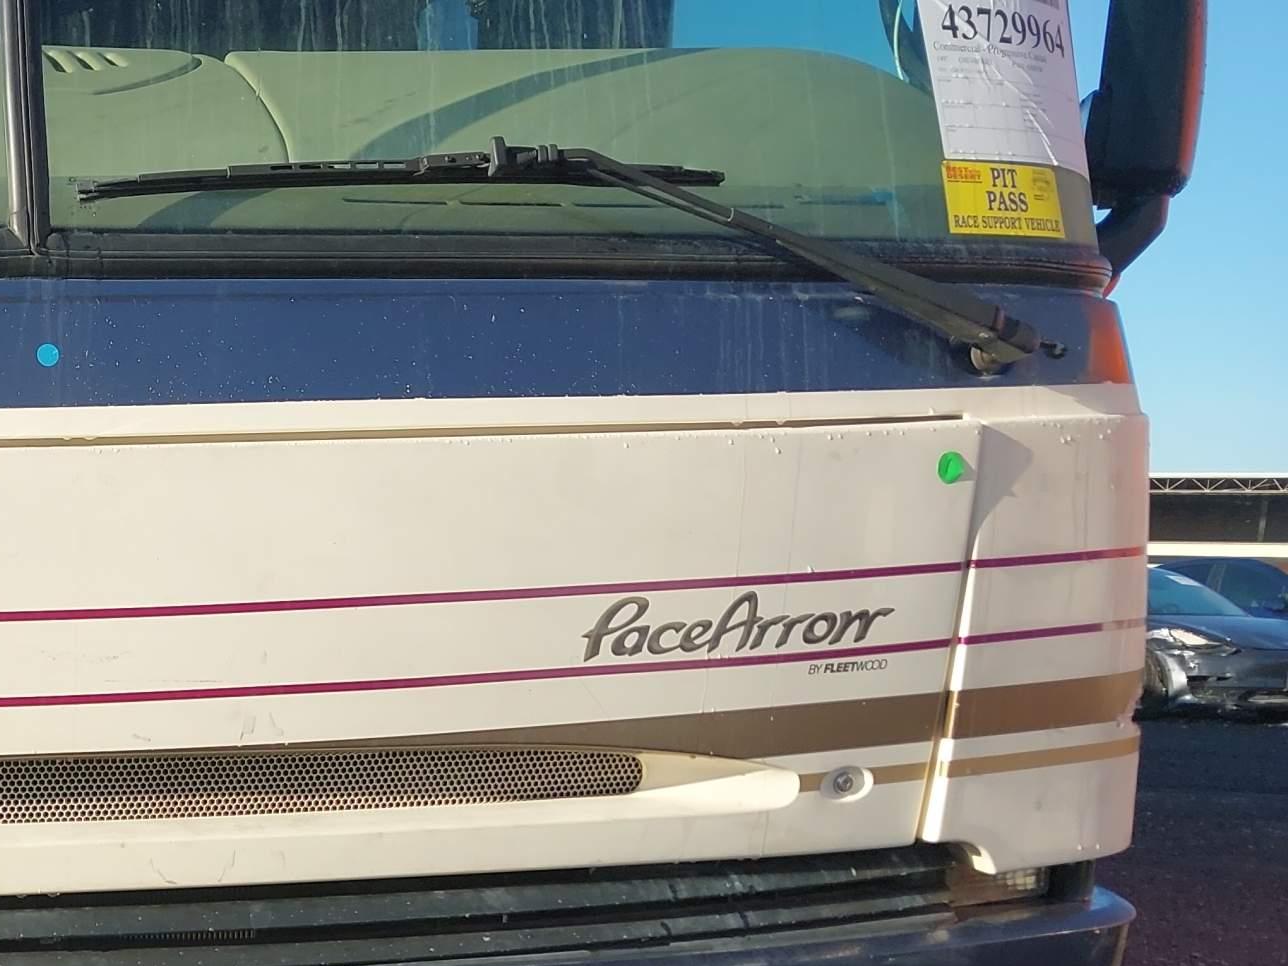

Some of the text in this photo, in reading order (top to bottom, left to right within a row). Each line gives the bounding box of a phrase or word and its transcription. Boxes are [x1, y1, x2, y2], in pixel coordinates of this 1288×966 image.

[941, 4, 1065, 58] 43729964
[990, 167, 1017, 188] PIT
[986, 191, 1029, 213] PASS
[954, 215, 1061, 233] RACE SUPPORT VEHICLE
[808, 659, 887, 675] BY FLEETWOOD
